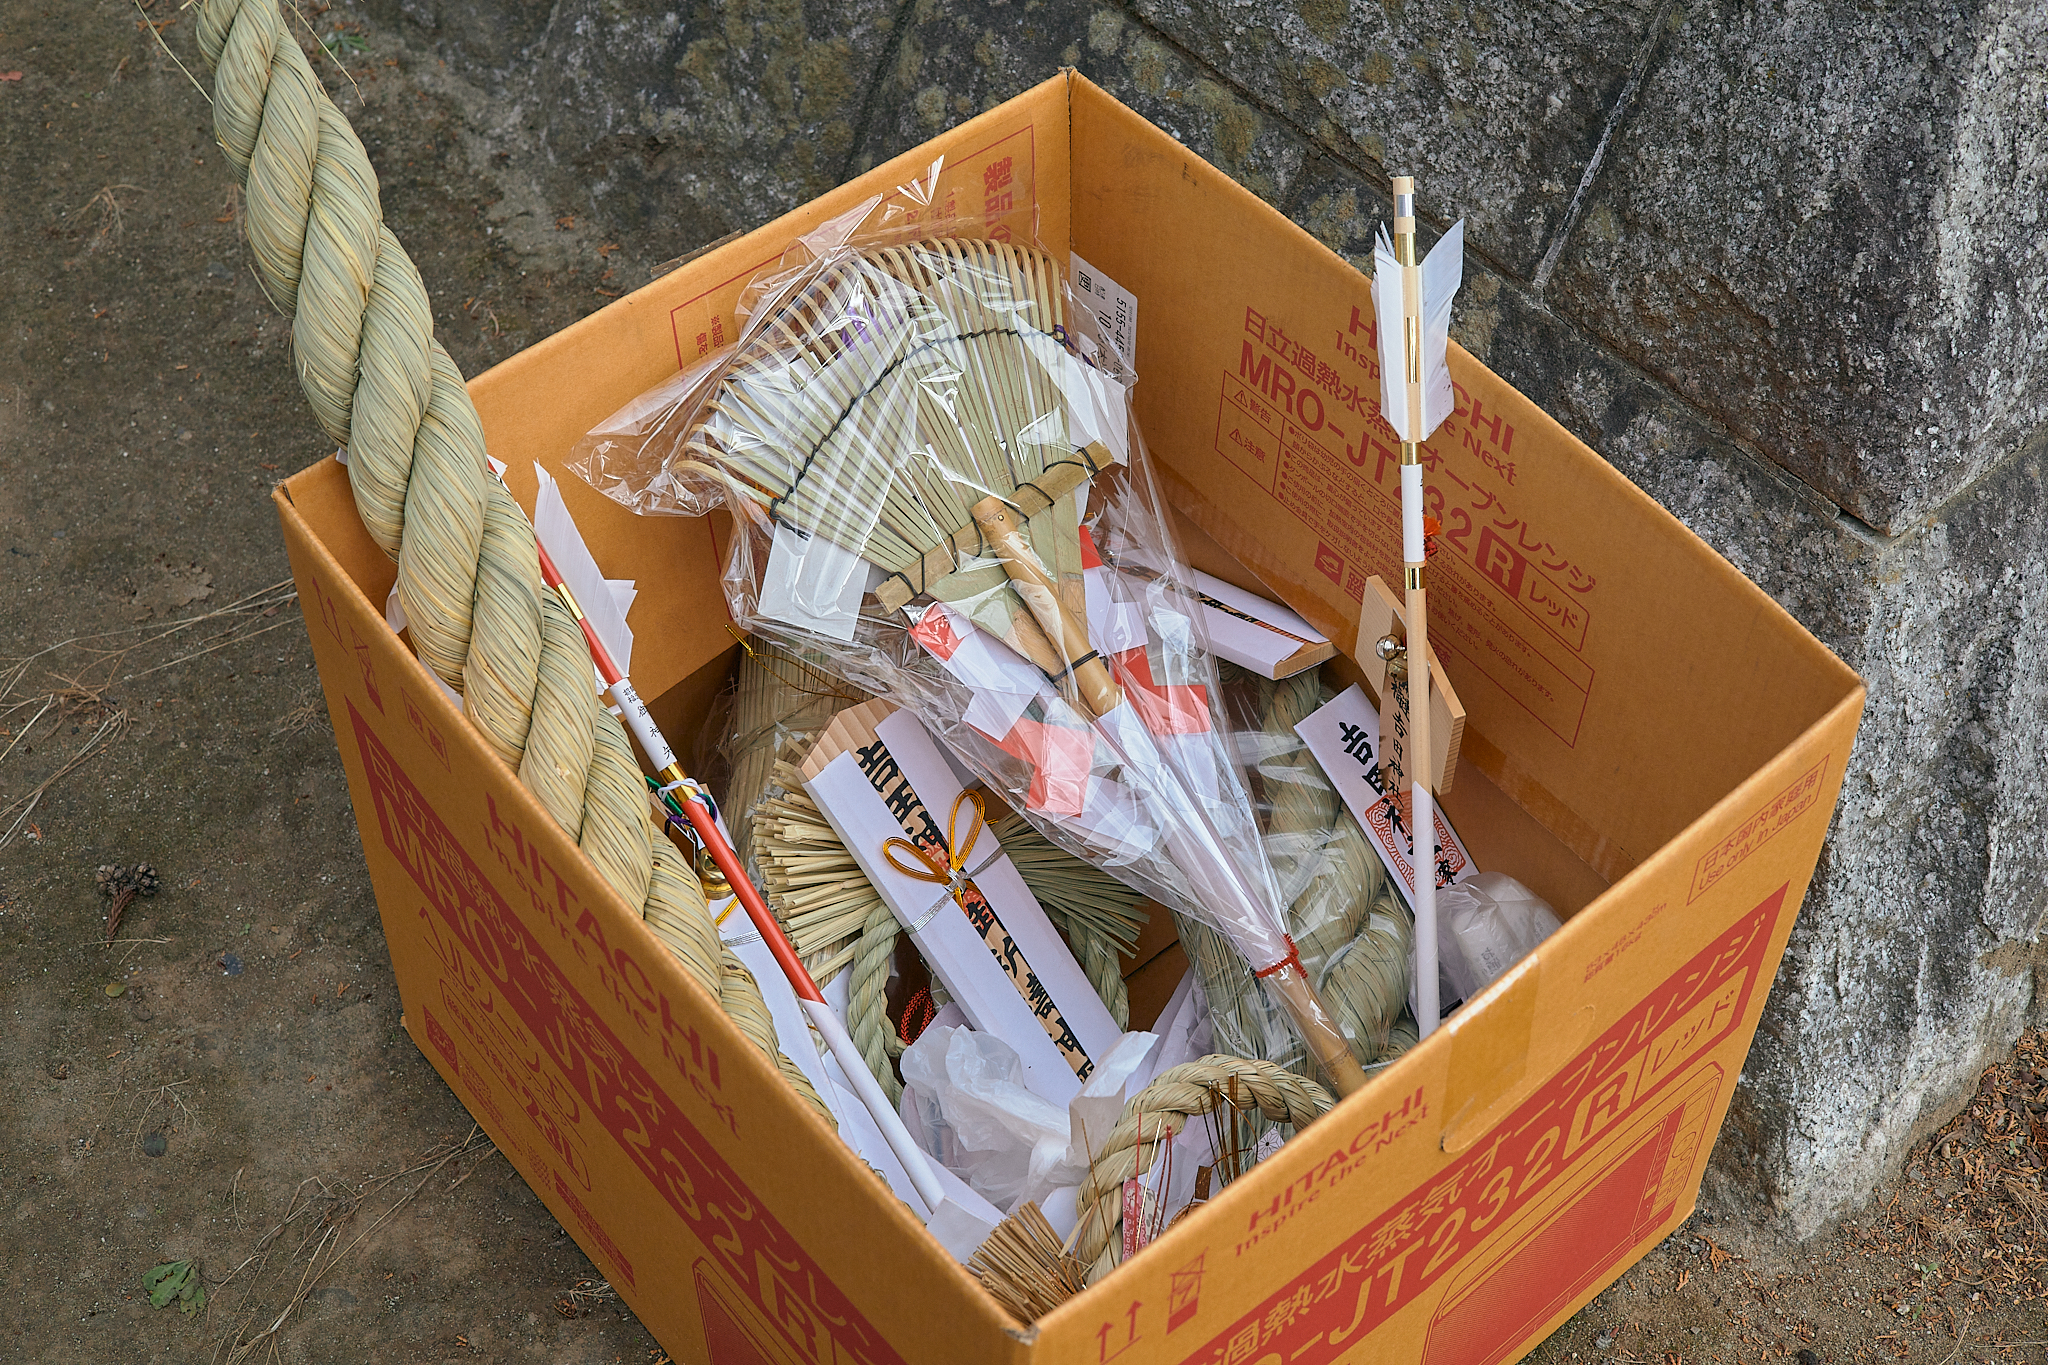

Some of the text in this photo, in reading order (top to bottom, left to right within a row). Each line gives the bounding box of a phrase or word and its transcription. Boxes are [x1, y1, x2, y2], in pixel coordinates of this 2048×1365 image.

[1239, 339, 1473, 556] MRO-JT32
[1529, 579, 1578, 629] レッド
[1243, 436, 1265, 464] 注意
[1245, 305, 1596, 593] 日立過熱水蒸オーブンレンジ
[1249, 398, 1272, 425] 警告
[1462, 427, 1517, 487] Next
[1698, 794, 1812, 891] Use only in Japan
[1702, 769, 1819, 873] 日本国内家庭用
[481, 821, 588, 966] Inspire
[598, 963, 651, 1037] the
[659, 1029, 742, 1141] Next
[485, 790, 722, 1091] HITACHI
[418, 906, 581, 1124] ヘルシーシェフ
[1650, 989, 1736, 1076] レッド
[1235, 1102, 1429, 1257] Inspire the Next
[1248, 1085, 1425, 1233] HITACHI
